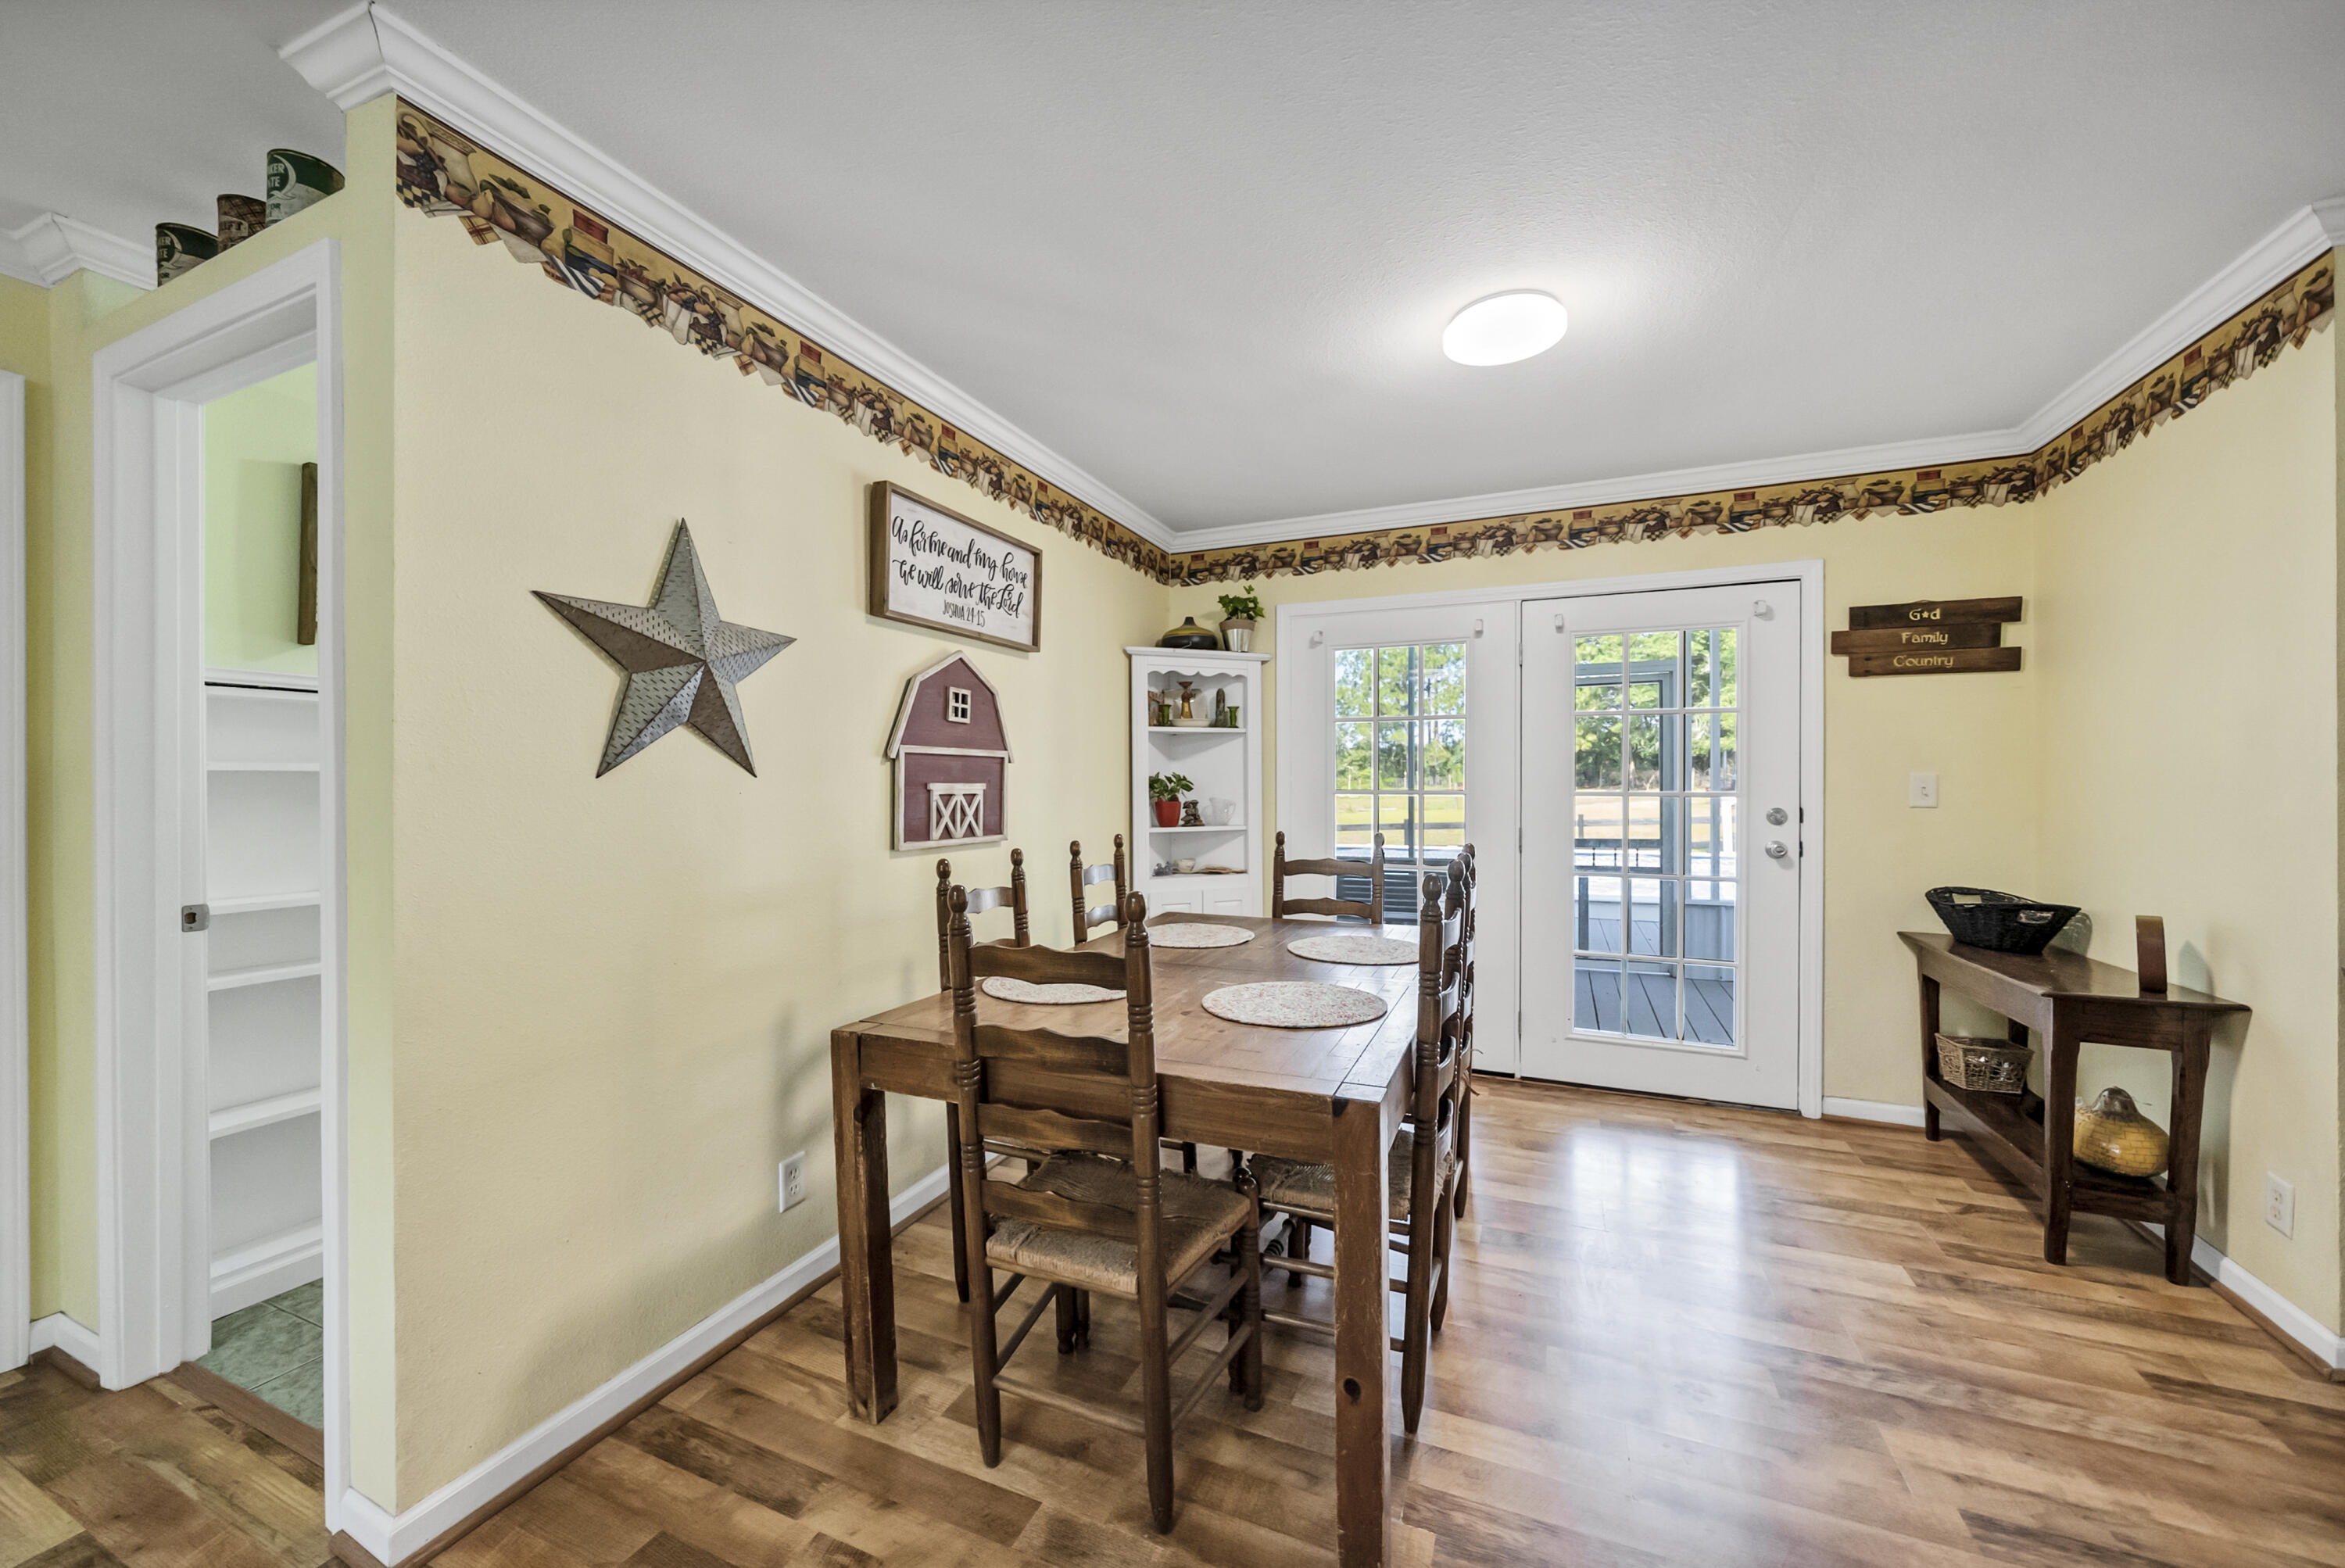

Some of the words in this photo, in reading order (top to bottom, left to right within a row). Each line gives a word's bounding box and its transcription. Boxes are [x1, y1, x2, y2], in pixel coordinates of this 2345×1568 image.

[892, 516, 908, 545] As
[909, 520, 926, 557] for
[927, 532, 947, 557] me
[947, 539, 976, 569] and
[973, 548, 998, 582] my
[1000, 552, 1028, 589] house
[918, 565, 943, 590] will
[944, 572, 976, 600] serve
[976, 582, 997, 610] the
[996, 584, 1024, 619] Lord
[943, 599, 965, 621] JOSHUA
[1901, 632, 1949, 646] Family
[1893, 655, 1953, 668] Country
